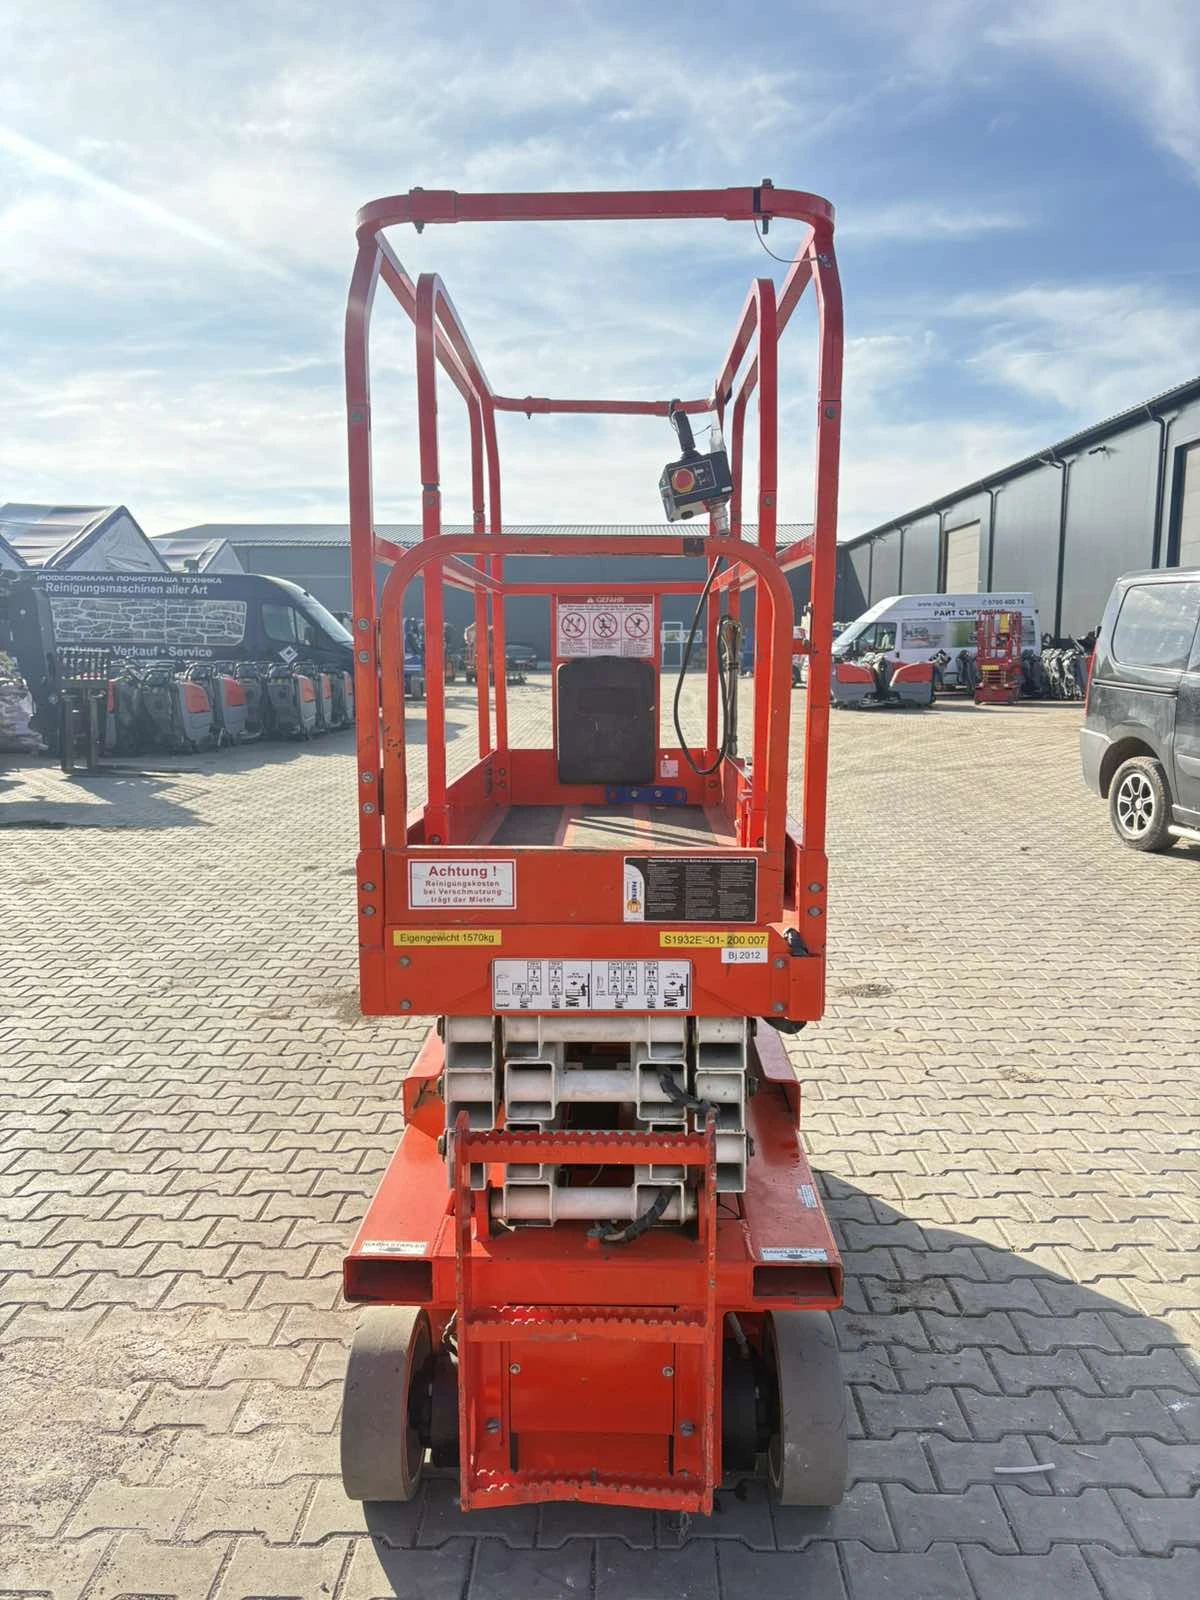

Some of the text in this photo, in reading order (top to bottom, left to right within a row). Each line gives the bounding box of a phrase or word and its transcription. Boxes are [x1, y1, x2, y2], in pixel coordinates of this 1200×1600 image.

[45, 582, 208, 595] Reinigungsmaschinen aller Art
[112, 645, 158, 657] Verkauf
[168, 646, 213, 657] Service
[429, 866, 488, 879] Achtung
[425, 880, 500, 888] Reinigungskosten
[438, 888, 502, 896] Verschmutzung
[400, 933, 495, 943] Eigengewicht 1570kg
[748, 934, 766, 945] 007
